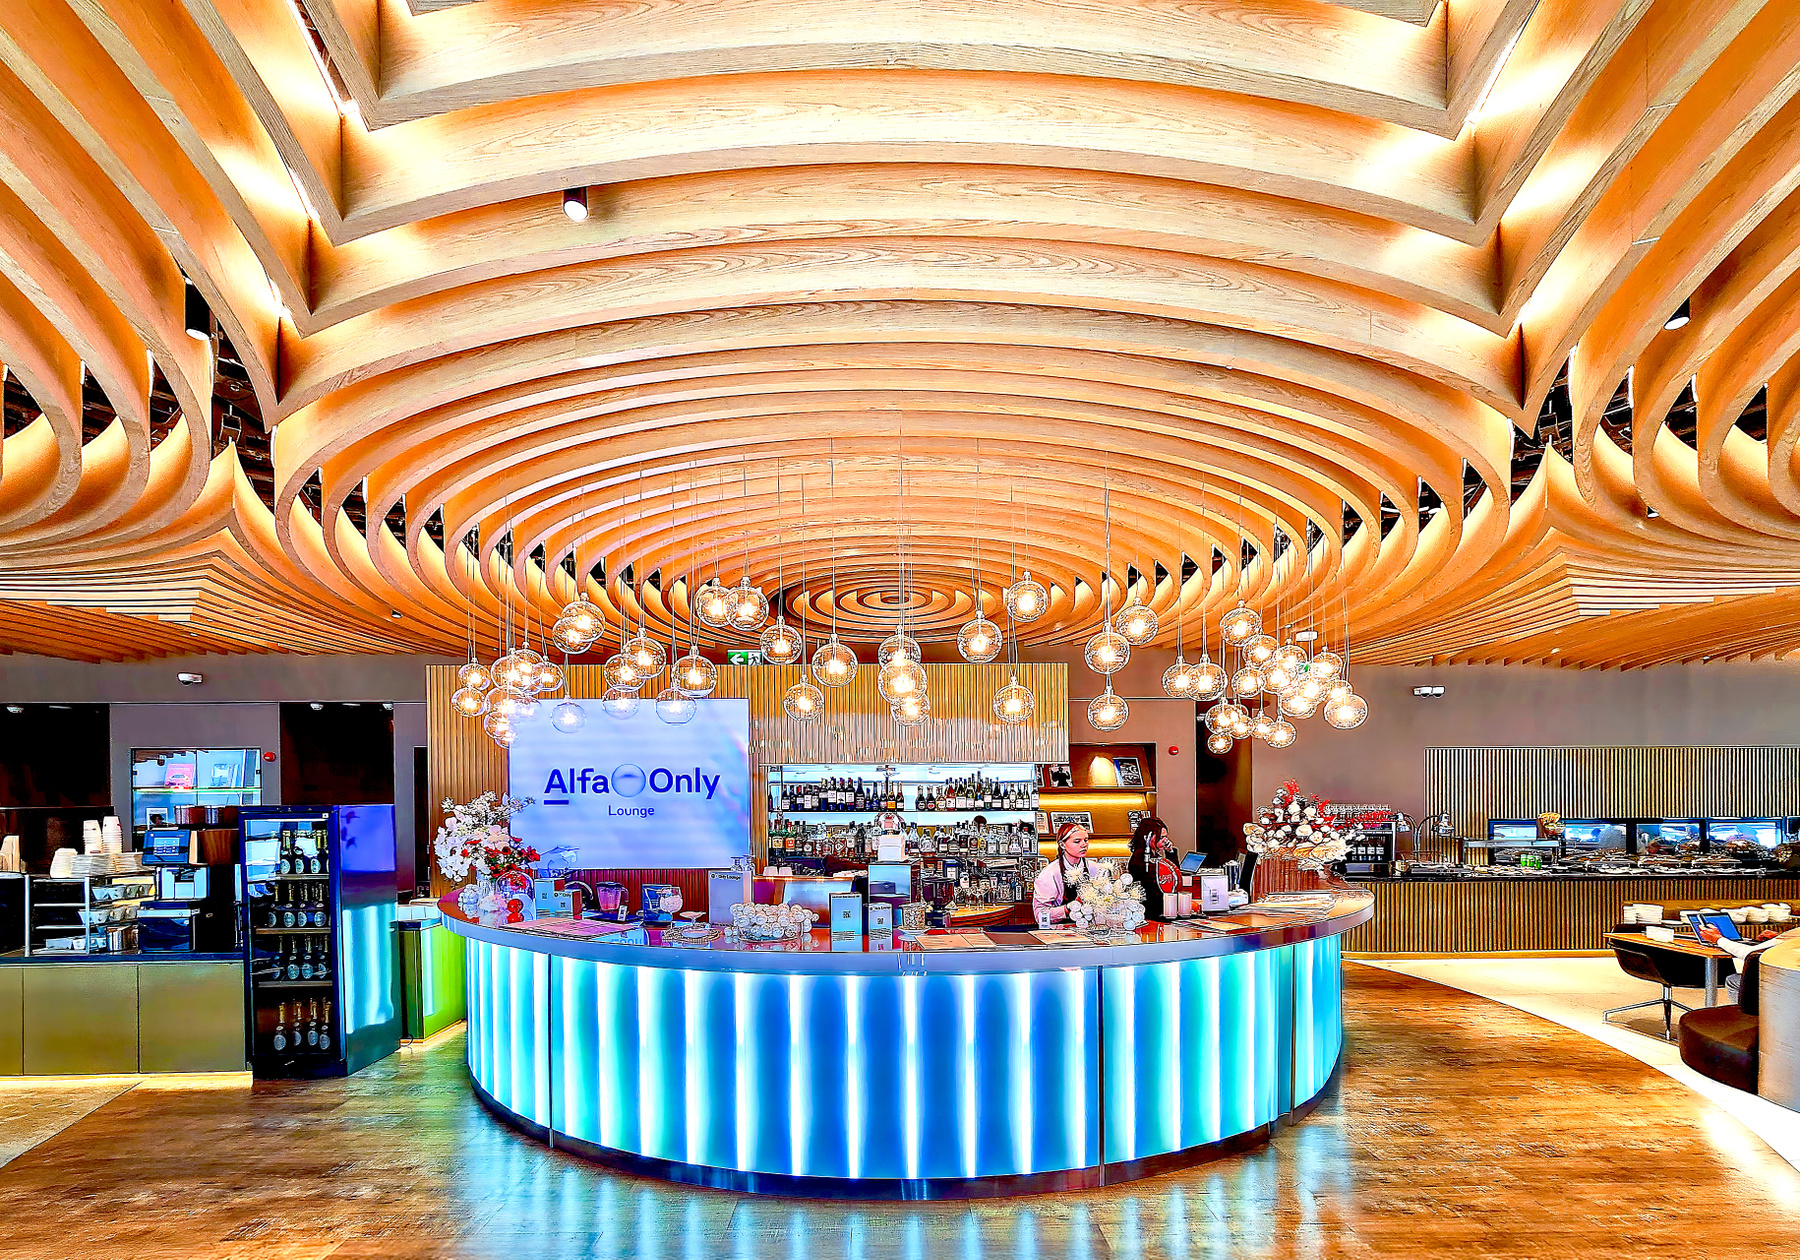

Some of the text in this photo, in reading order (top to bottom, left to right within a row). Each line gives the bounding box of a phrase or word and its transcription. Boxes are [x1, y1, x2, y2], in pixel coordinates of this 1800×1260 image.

[544, 767, 721, 800] Alfa Only
[608, 805, 655, 818] Lounge
